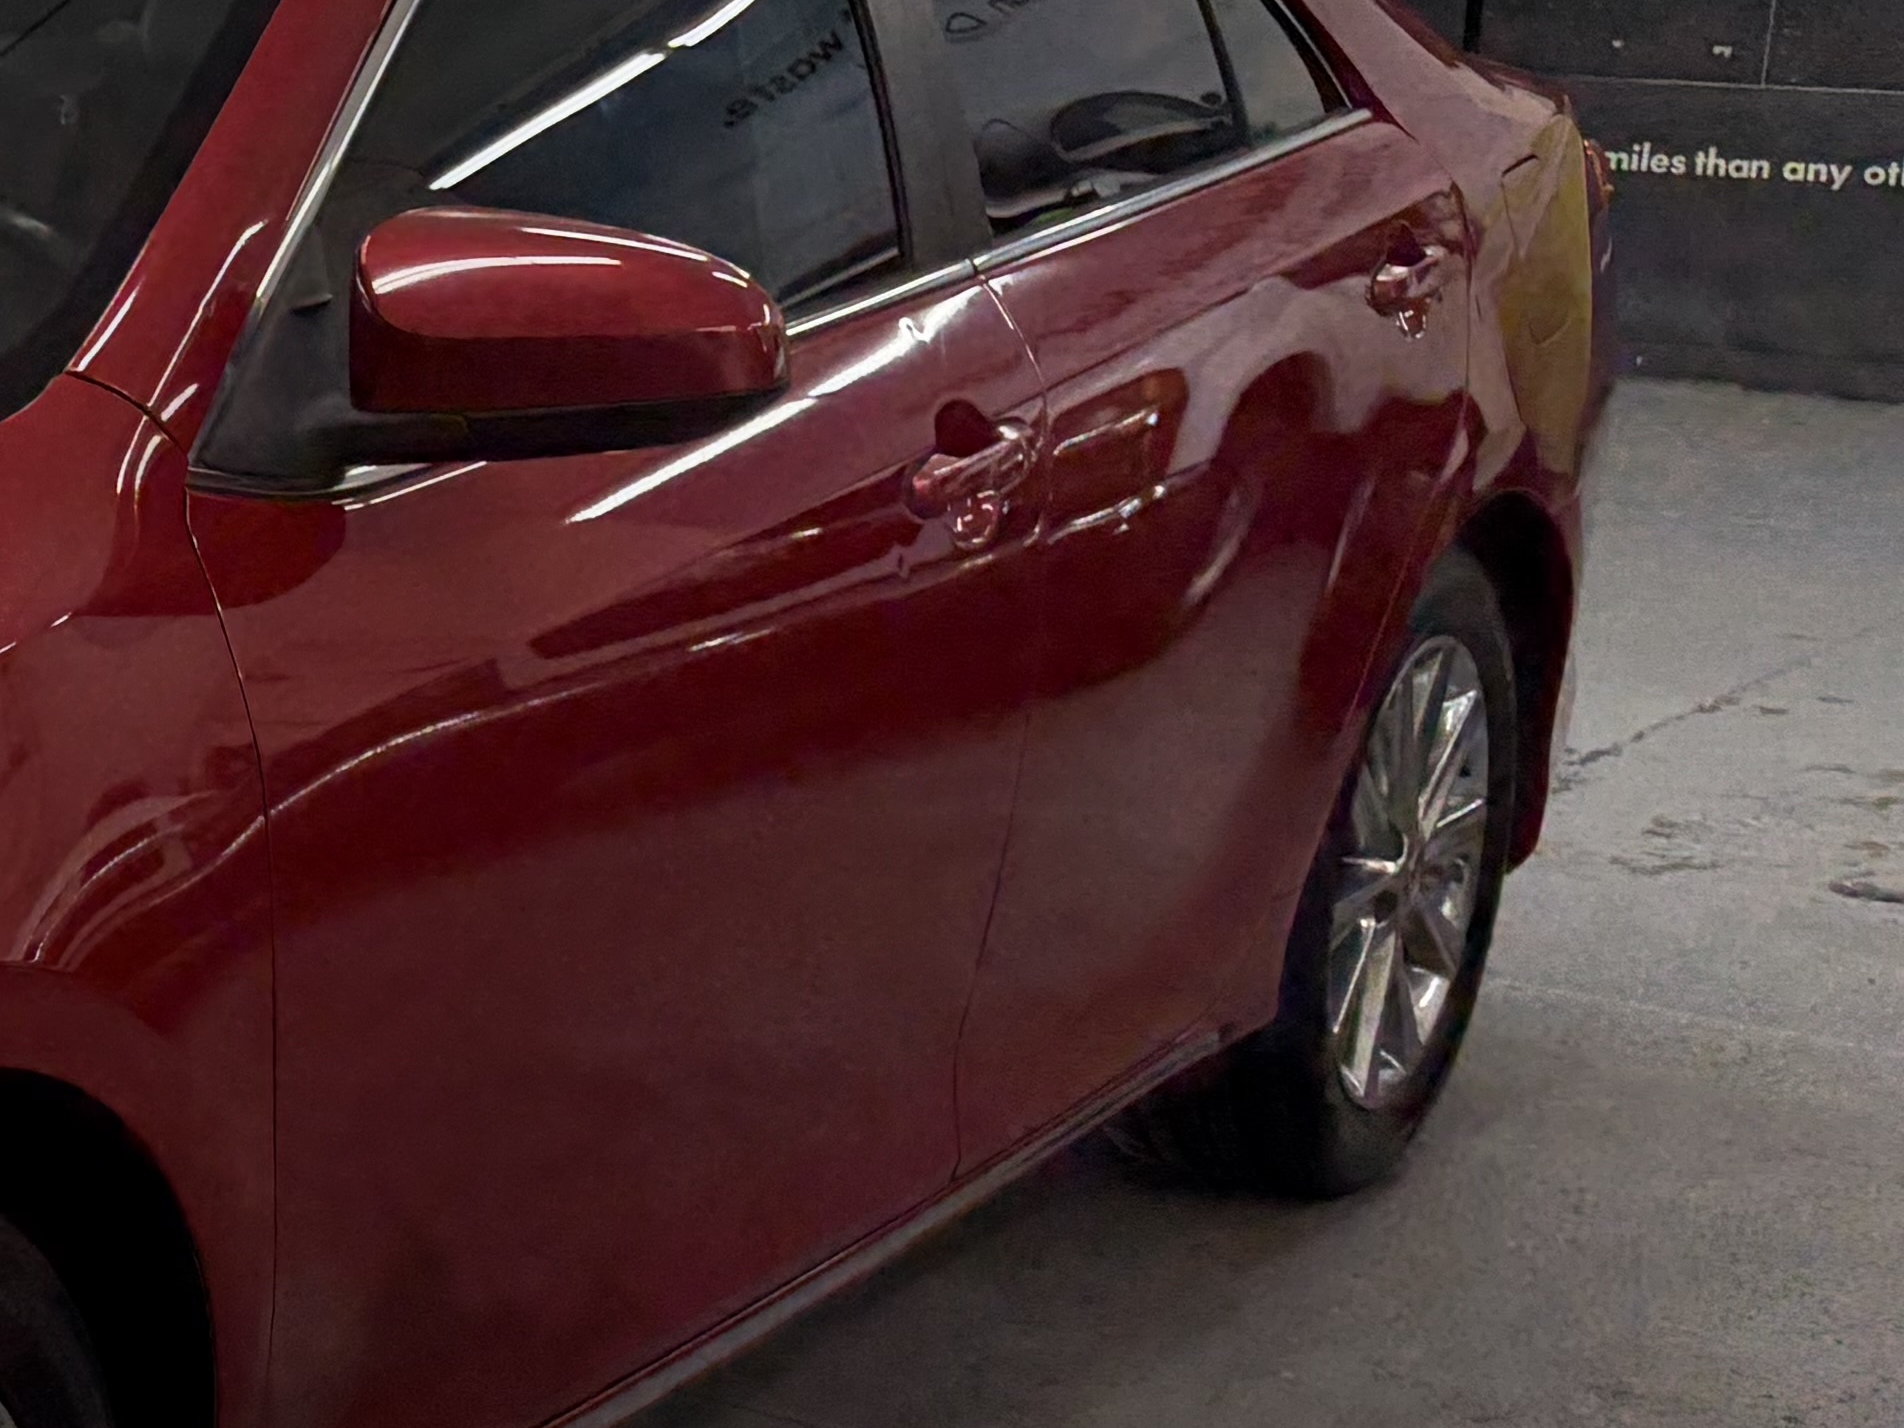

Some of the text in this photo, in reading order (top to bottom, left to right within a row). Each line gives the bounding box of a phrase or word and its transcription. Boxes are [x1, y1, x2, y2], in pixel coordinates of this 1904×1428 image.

[1694, 145, 1771, 180] than
[1781, 159, 1853, 191] any
[1863, 158, 1904, 187] ot
